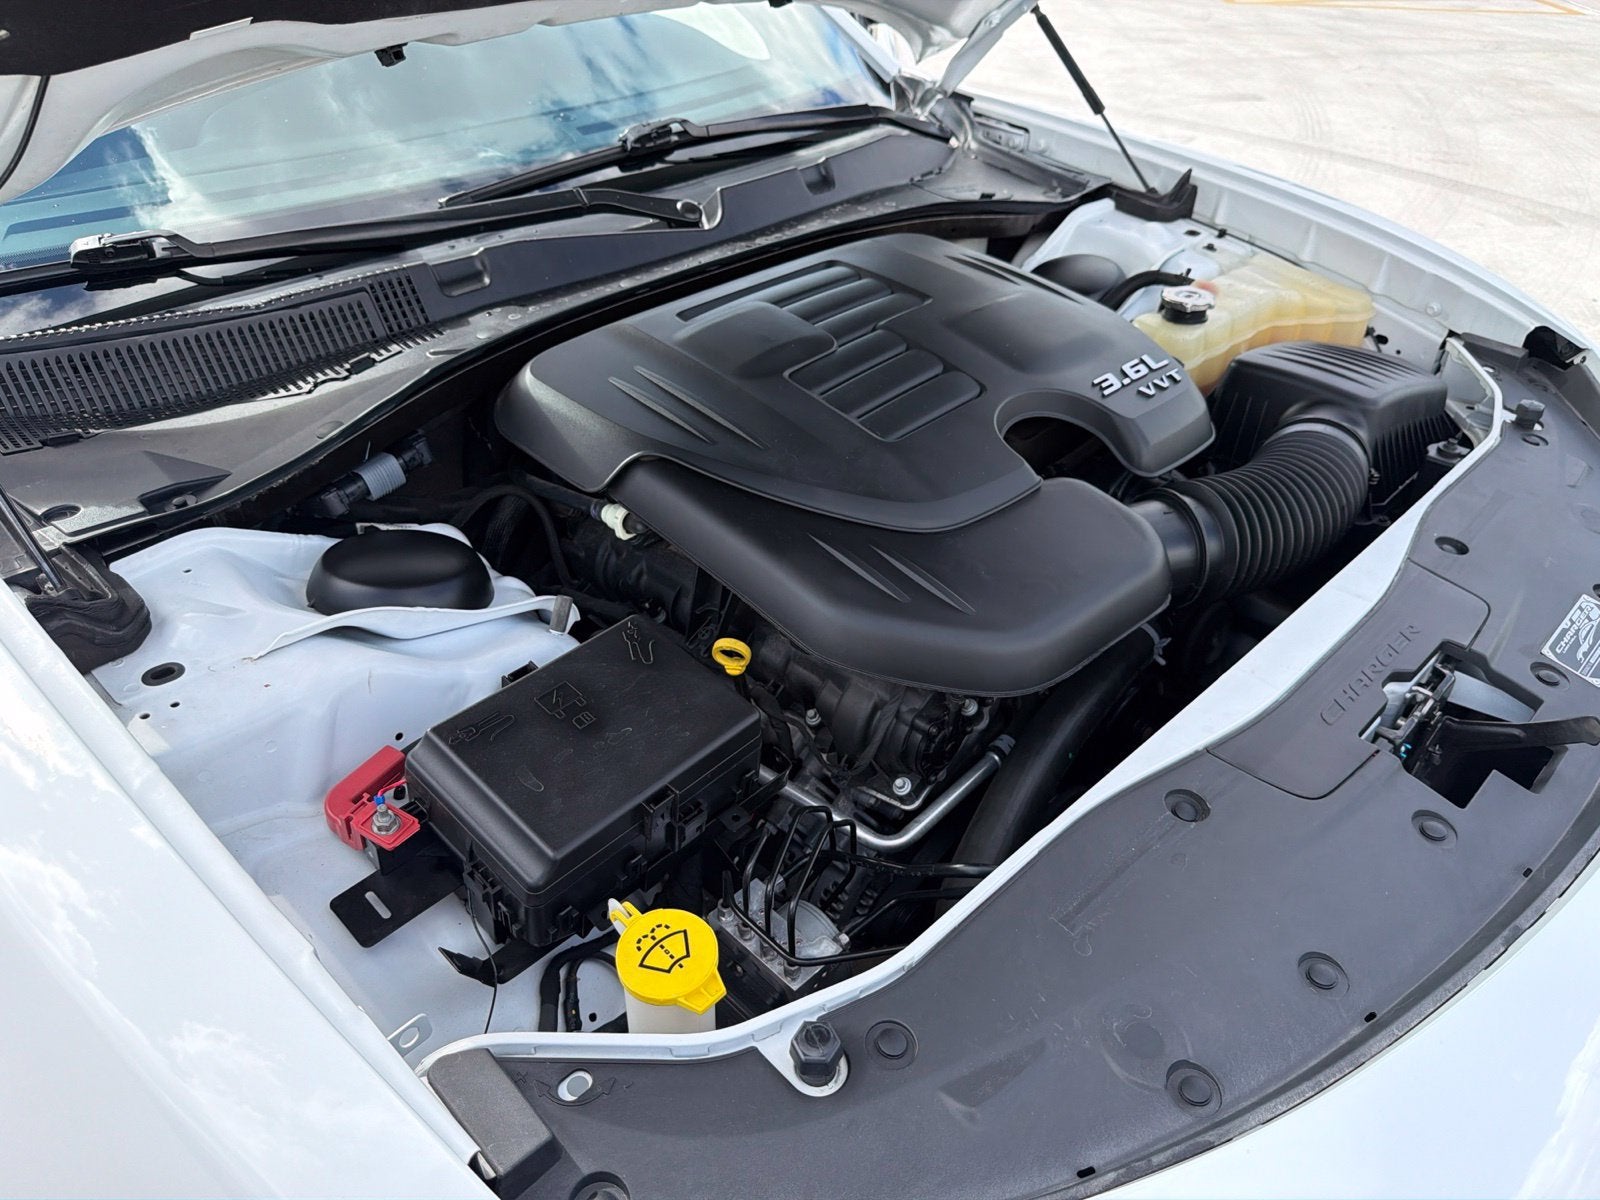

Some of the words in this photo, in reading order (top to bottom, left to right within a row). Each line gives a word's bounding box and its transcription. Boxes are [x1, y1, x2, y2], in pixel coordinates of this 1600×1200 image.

[1091, 354, 1169, 397] 3.6L
[1137, 368, 1182, 397] VVT
[1555, 605, 1592, 654] CHARGER
[1320, 624, 1421, 726] CHARGER
